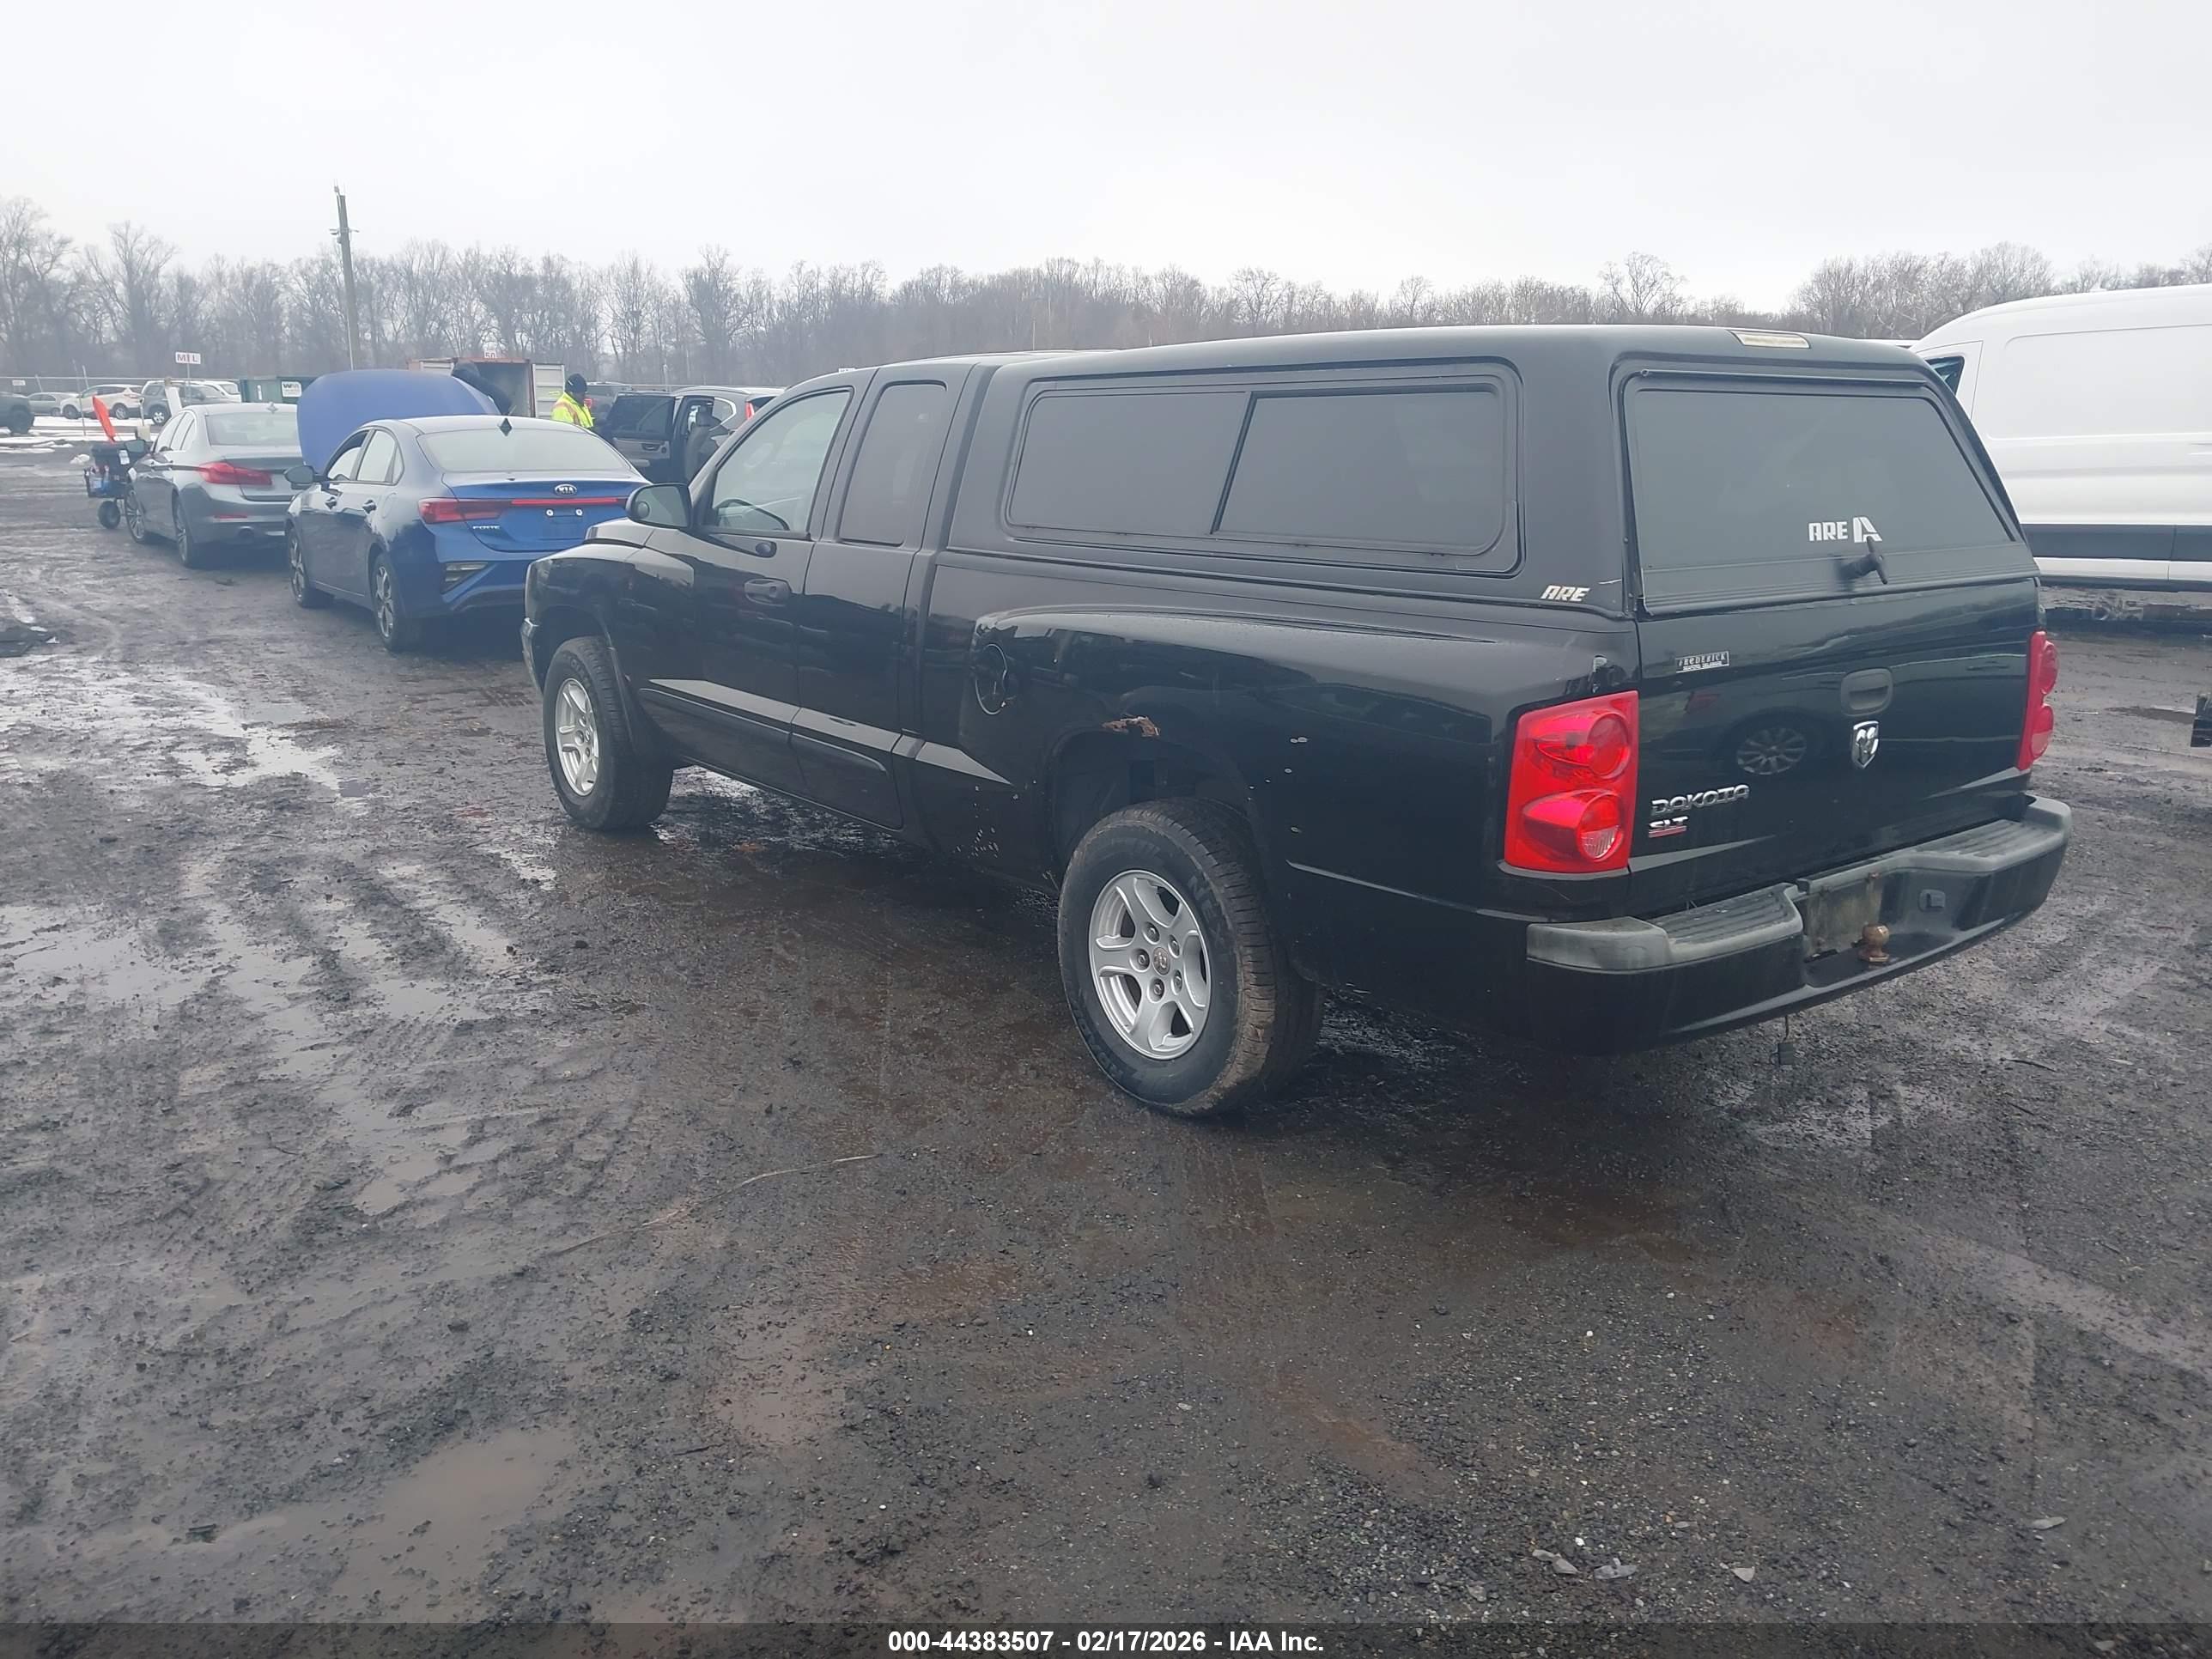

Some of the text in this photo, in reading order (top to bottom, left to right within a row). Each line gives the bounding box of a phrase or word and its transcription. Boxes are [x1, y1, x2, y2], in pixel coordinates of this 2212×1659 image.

[1808, 521, 1848, 542] ARE
[1540, 585, 1591, 602] ARE
[1650, 784, 1750, 816] DAKOTA
[1649, 816, 1688, 830] SLT
